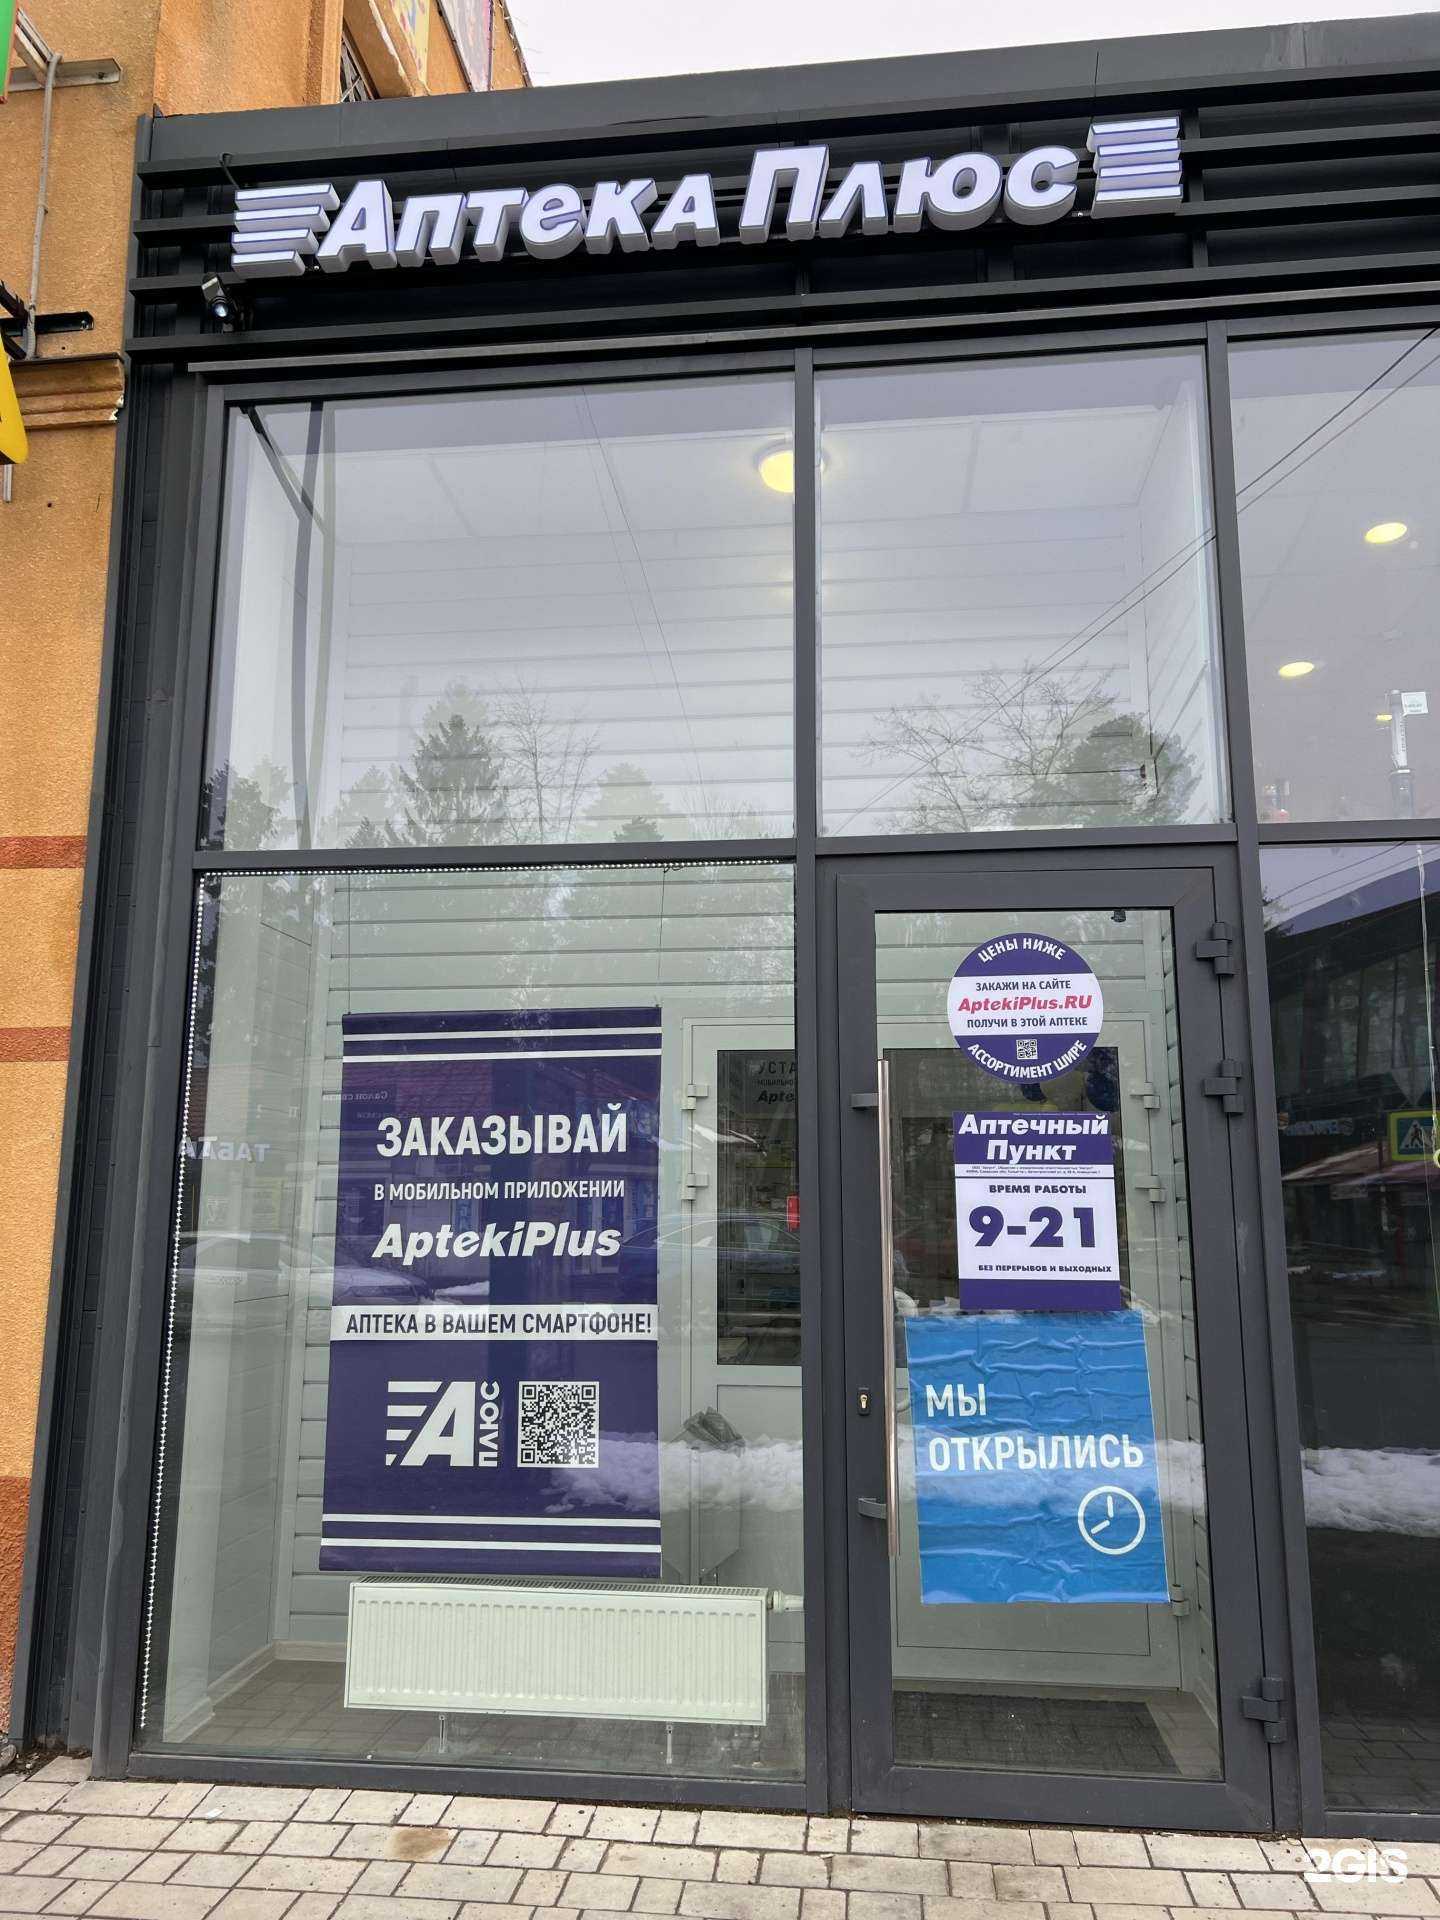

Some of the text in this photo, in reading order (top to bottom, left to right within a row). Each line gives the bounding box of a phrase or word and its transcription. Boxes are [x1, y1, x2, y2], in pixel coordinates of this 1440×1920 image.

[978, 938, 1066, 963] ЦЕНЫ НИЖЕ
[976, 978, 1071, 992] ЗАКАЖИ НА САЙТЕ
[958, 995, 1092, 1014] AptekiPlus.RU
[967, 1019, 1008, 1028] ПОЛУЧИ
[1021, 1016, 1046, 1026] ЭТОЙ
[1049, 1017, 1087, 1026] АПТЕКЕ
[968, 1040, 1087, 1078] АССОРТИМЕНТ ШИРЕ
[377, 1103, 627, 1157] ЗАКАЗЫВАЙ
[959, 1114, 1108, 1135] Аптечный
[987, 1140, 1076, 1164] Пункт
[374, 1180, 624, 1201] В МОБИЛЬНОМ ПРИЛОЖЕНИИ
[989, 1185, 1086, 1194] ВРЕМЯ РАБОТЫ
[969, 1206, 1095, 1248] 9-21
[372, 1221, 622, 1265] AptekiPlus
[1059, 1265, 1112, 1273] ВЫХОДНЫХ
[347, 1311, 651, 1335] АПТЕКА В ВАШЕМ СМАРТФОНЕ!
[926, 1384, 986, 1418] МЫ
[479, 1380, 500, 1467] ПЛЮС
[928, 1434, 1144, 1472] ОТКРЫЛИСЬ
